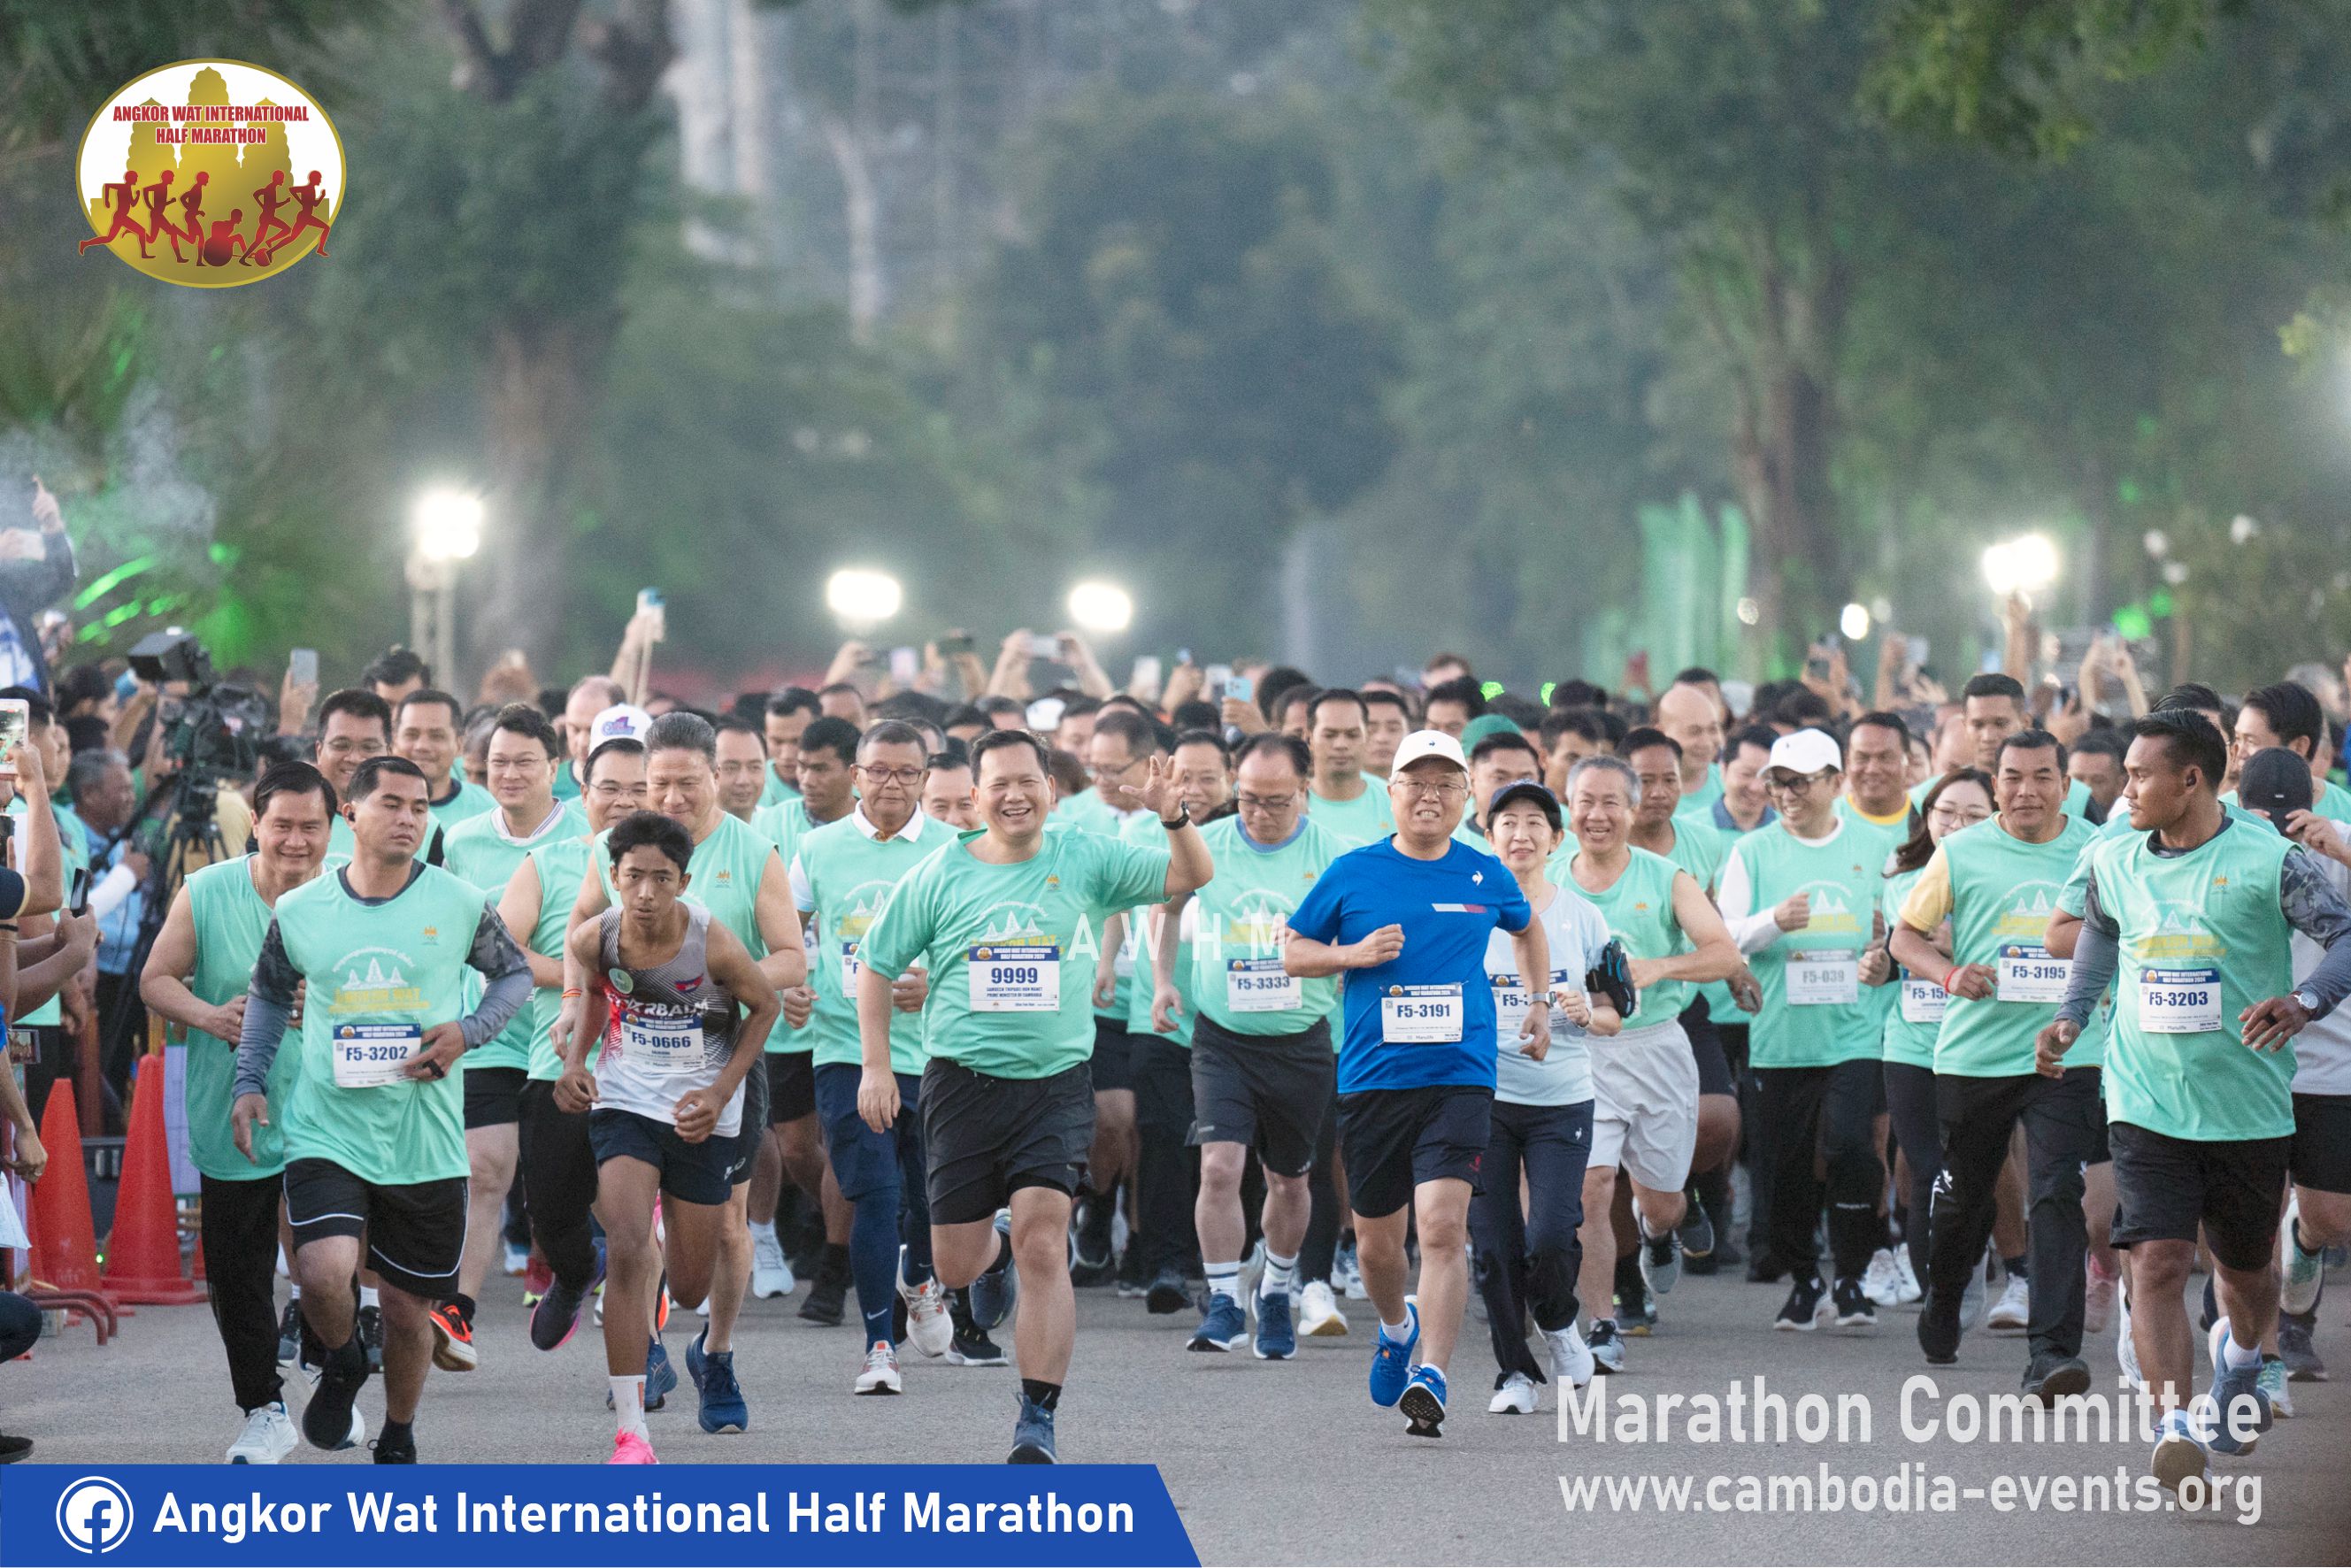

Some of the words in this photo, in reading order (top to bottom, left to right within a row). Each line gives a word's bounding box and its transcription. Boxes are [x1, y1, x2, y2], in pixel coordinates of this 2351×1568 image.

[991, 967, 1038, 984] 9999
[2012, 965, 2066, 979] F5-3195
[1237, 976, 1290, 990] F5-3333
[2149, 991, 2209, 1006] F5-3203
[1397, 1004, 1450, 1018] F5-3191
[632, 1032, 691, 1048] F5-0666
[346, 1046, 408, 1061] F5-3202
